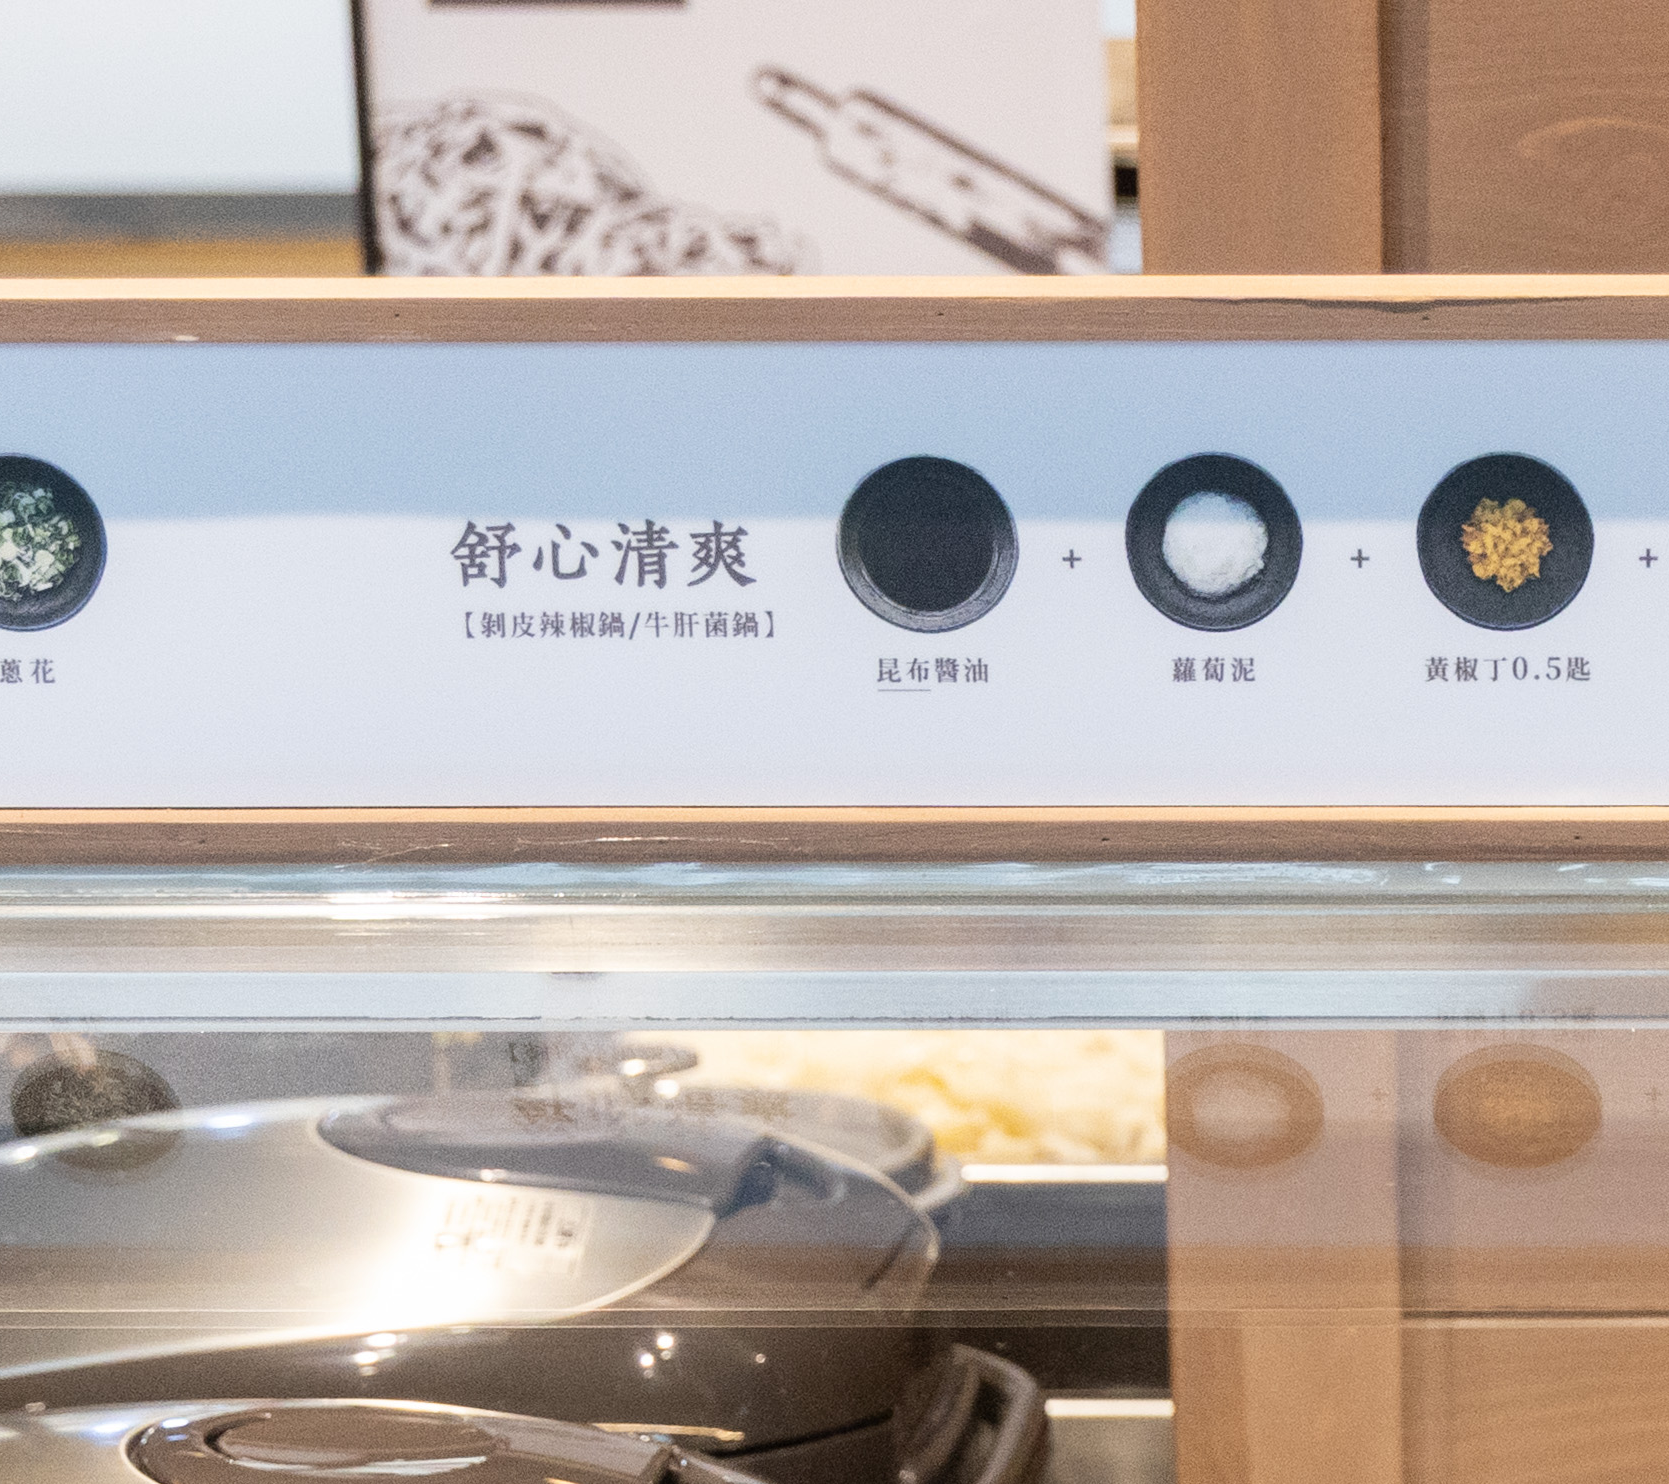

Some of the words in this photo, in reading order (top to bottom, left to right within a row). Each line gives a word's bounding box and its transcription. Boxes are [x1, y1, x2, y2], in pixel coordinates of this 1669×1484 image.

[450, 518, 757, 590] 舒心清爽
[876, 656, 989, 684] 昆布醬油
[1172, 656, 1256, 683] 蘿蔔泥
